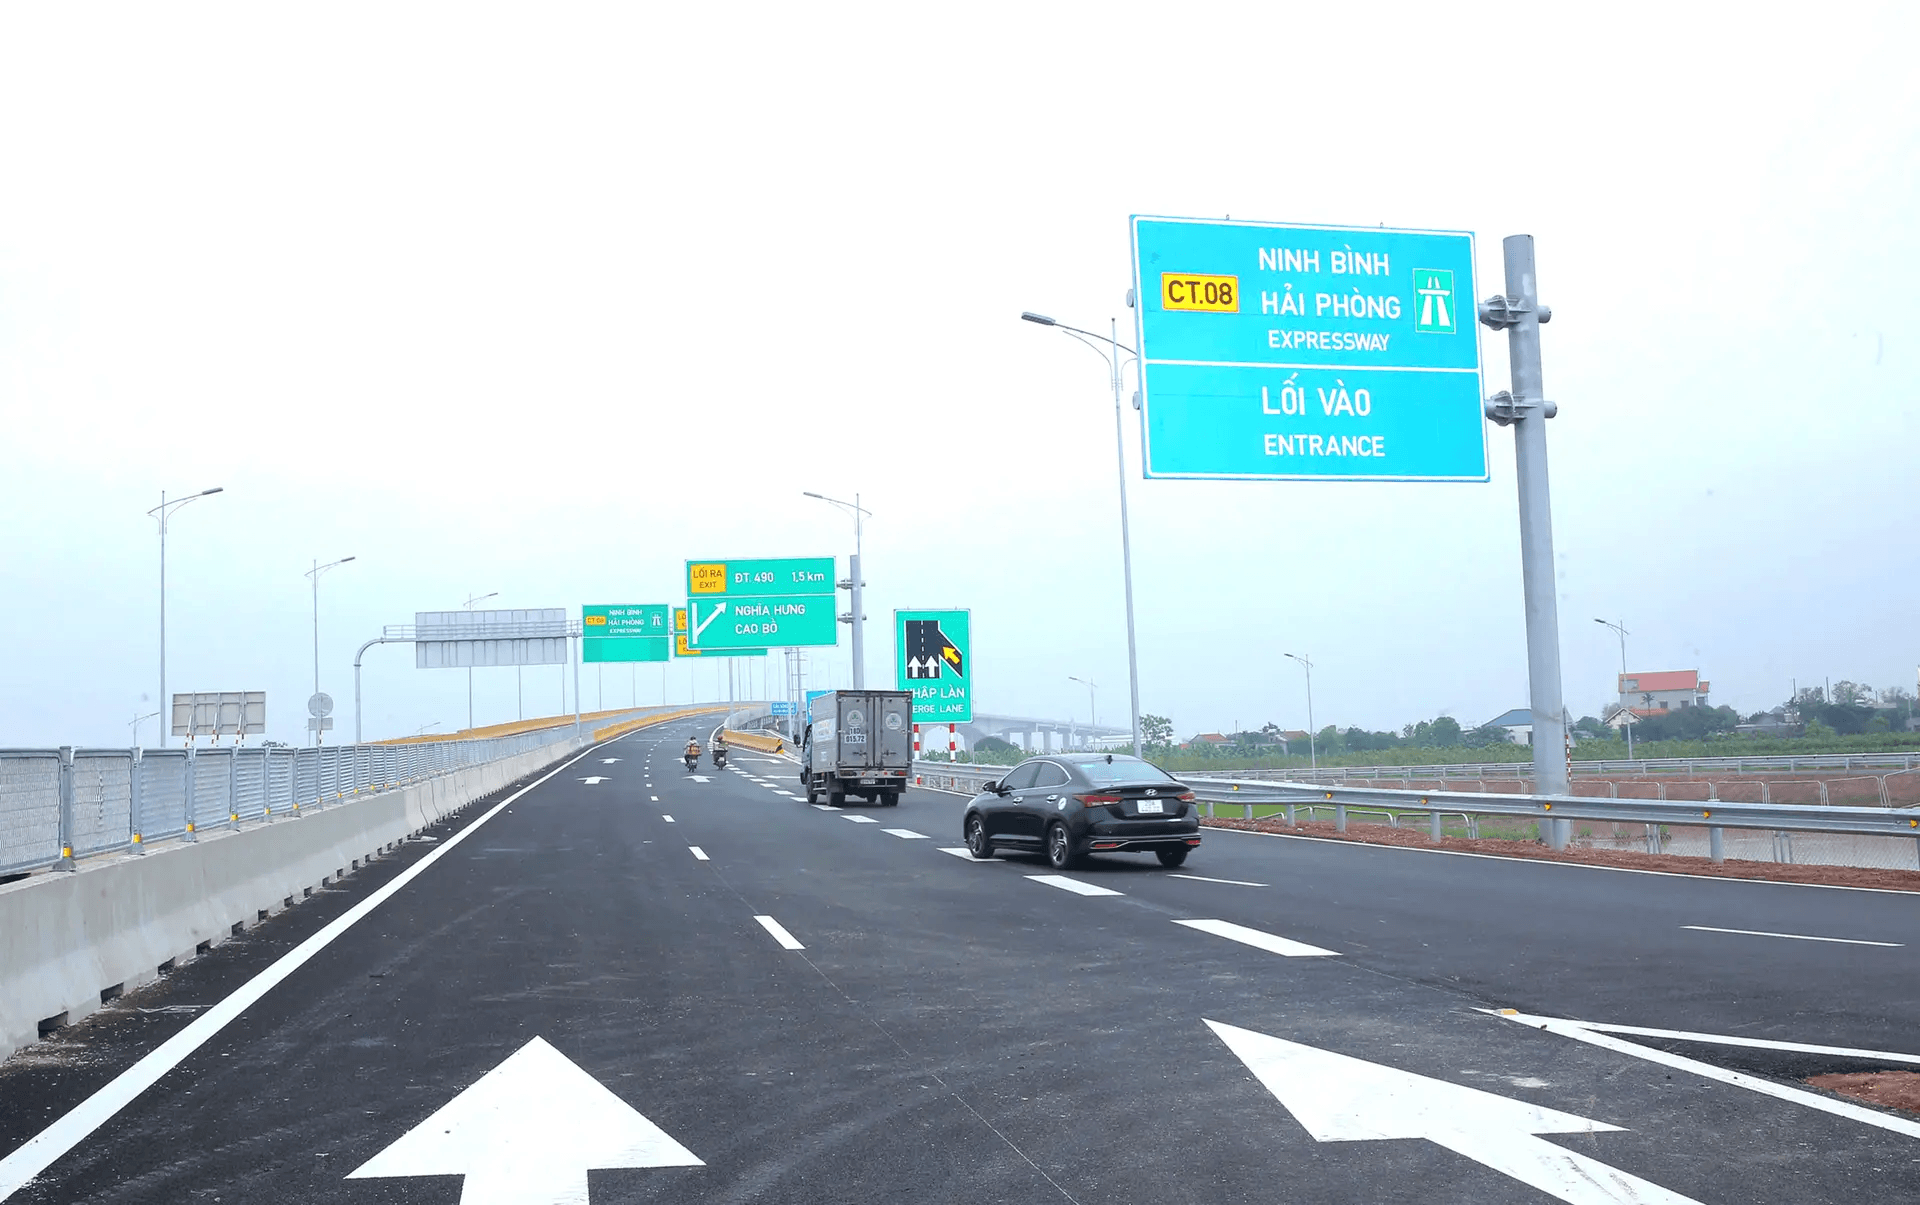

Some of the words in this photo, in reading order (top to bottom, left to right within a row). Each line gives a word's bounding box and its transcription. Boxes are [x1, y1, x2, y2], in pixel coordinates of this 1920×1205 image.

[1258, 247, 1320, 274] NINH
[1331, 245, 1390, 276] BÌNH
[1168, 280, 1233, 305] CT.08
[1262, 283, 1305, 317] HẢI
[1316, 287, 1401, 319] PHÒNG
[1268, 330, 1390, 352] EXPRESSWAY
[1262, 372, 1305, 415] LỐI
[1317, 379, 1371, 416] VÀO
[1264, 434, 1385, 457] ENTRANCE
[693, 567, 708, 578] LỐI
[710, 569, 723, 578] RA
[754, 572, 774, 583] 490
[807, 572, 825, 581] km
[626, 607, 643, 616] BÌNH
[735, 603, 770, 616] NGHĨA
[735, 624, 759, 634] CAO
[904, 685, 937, 701] HẬP
[940, 684, 965, 699] LÀN
[912, 704, 936, 714] ERGE
[939, 704, 965, 713] LANE
